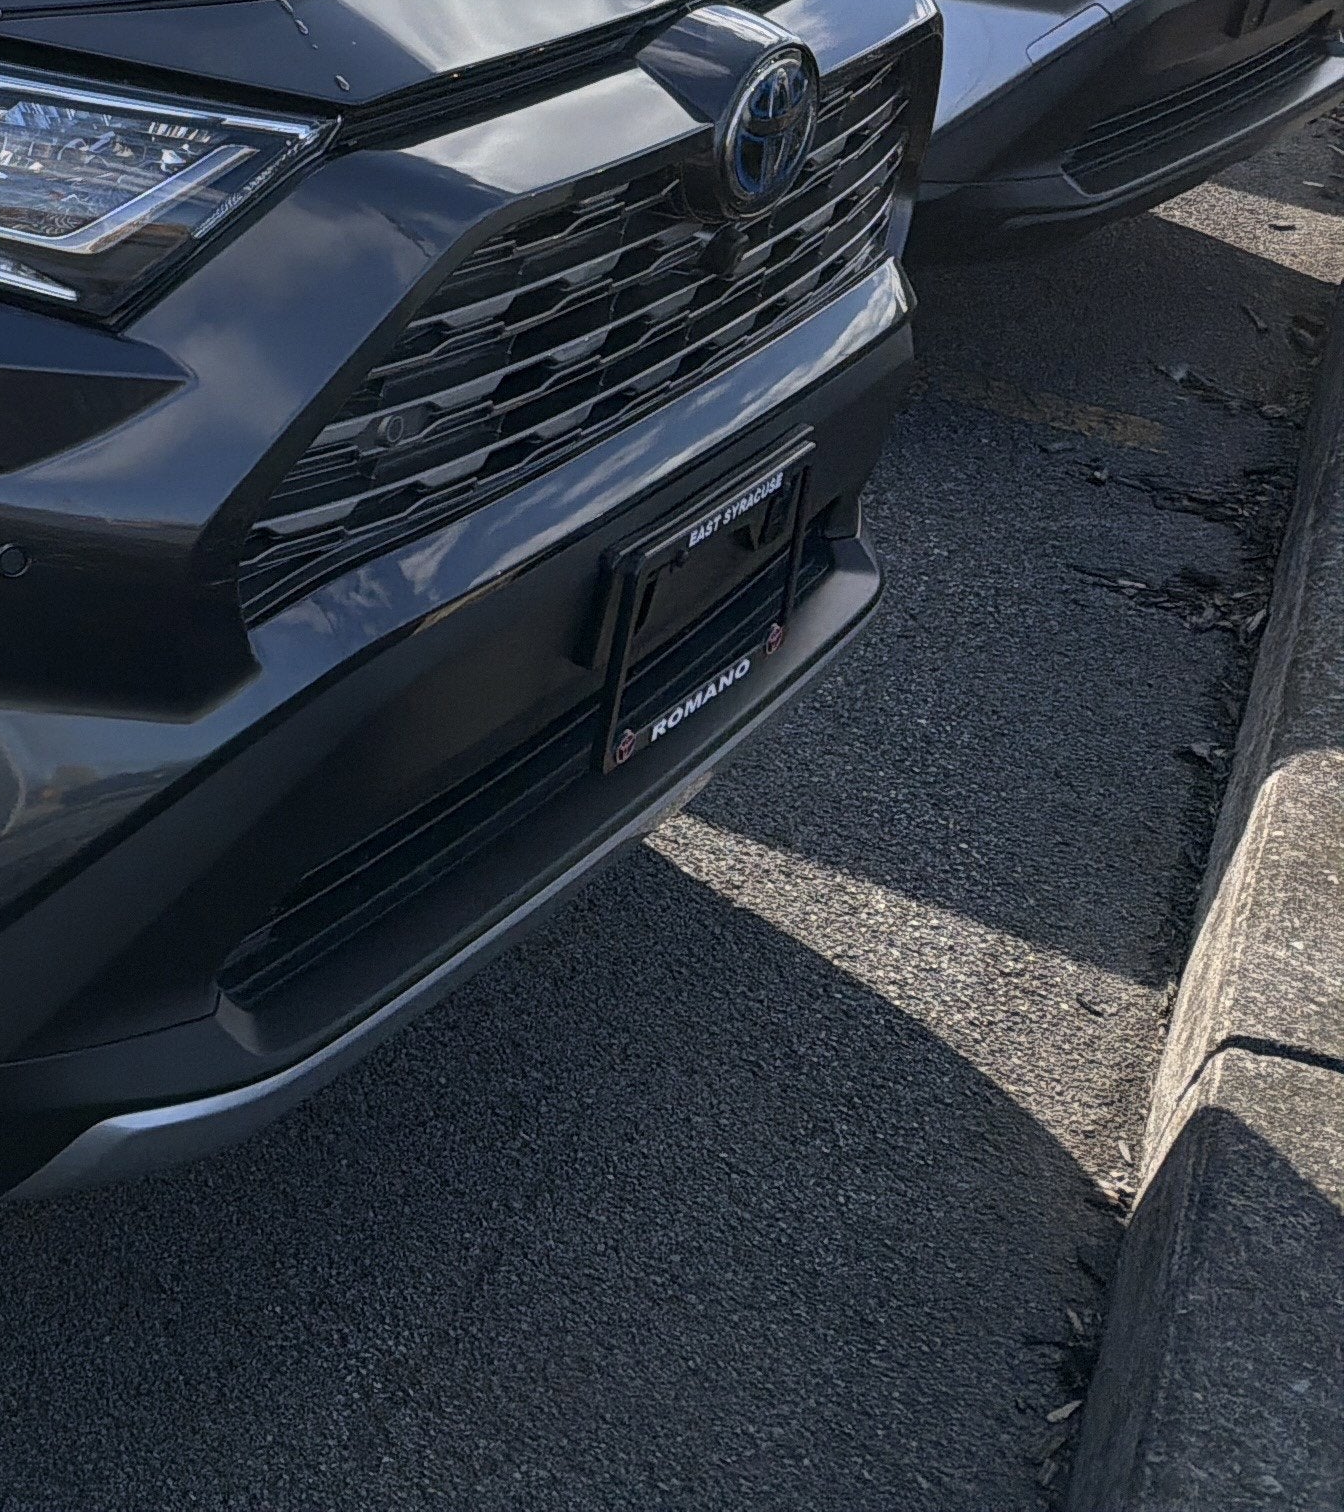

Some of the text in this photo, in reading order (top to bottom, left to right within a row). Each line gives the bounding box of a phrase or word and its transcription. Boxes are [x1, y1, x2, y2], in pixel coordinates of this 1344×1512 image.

[688, 472, 783, 548] EAST SYRACUSE
[651, 658, 750, 742] ROMANO
